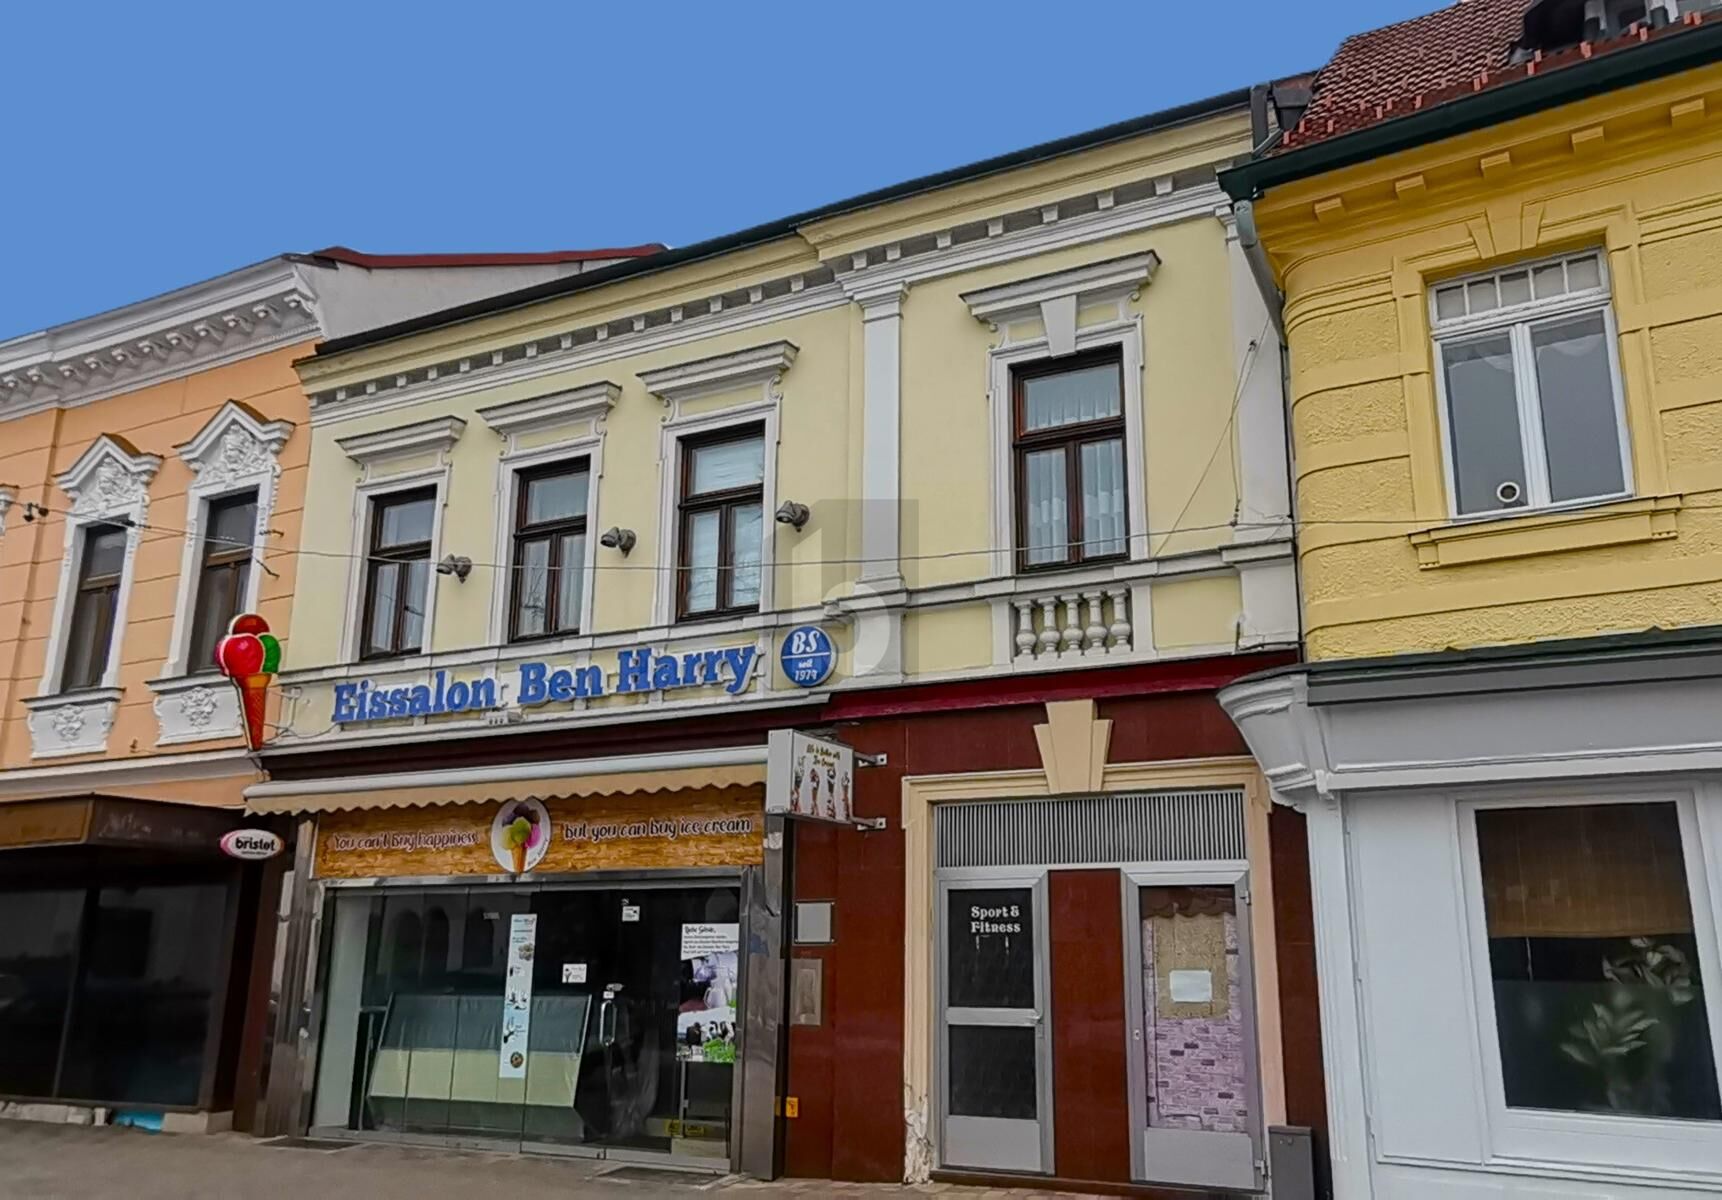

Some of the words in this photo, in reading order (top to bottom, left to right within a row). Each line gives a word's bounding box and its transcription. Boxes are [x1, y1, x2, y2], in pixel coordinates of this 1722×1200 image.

[791, 629, 820, 655] BS
[332, 670, 497, 722] Eissalon
[517, 662, 603, 704] Ben
[617, 645, 757, 696] Harry
[334, 832, 354, 849] You
[391, 831, 416, 852] buy
[417, 828, 479, 849] happiness
[564, 822, 587, 840] but
[591, 824, 616, 842] you
[620, 823, 646, 837] can
[650, 818, 678, 840] buy
[680, 817, 700, 834] ice
[704, 817, 752, 834] cream
[971, 905, 1009, 920] Sport
[1010, 905, 1020, 917] &
[971, 921, 1021, 933] Fitness
